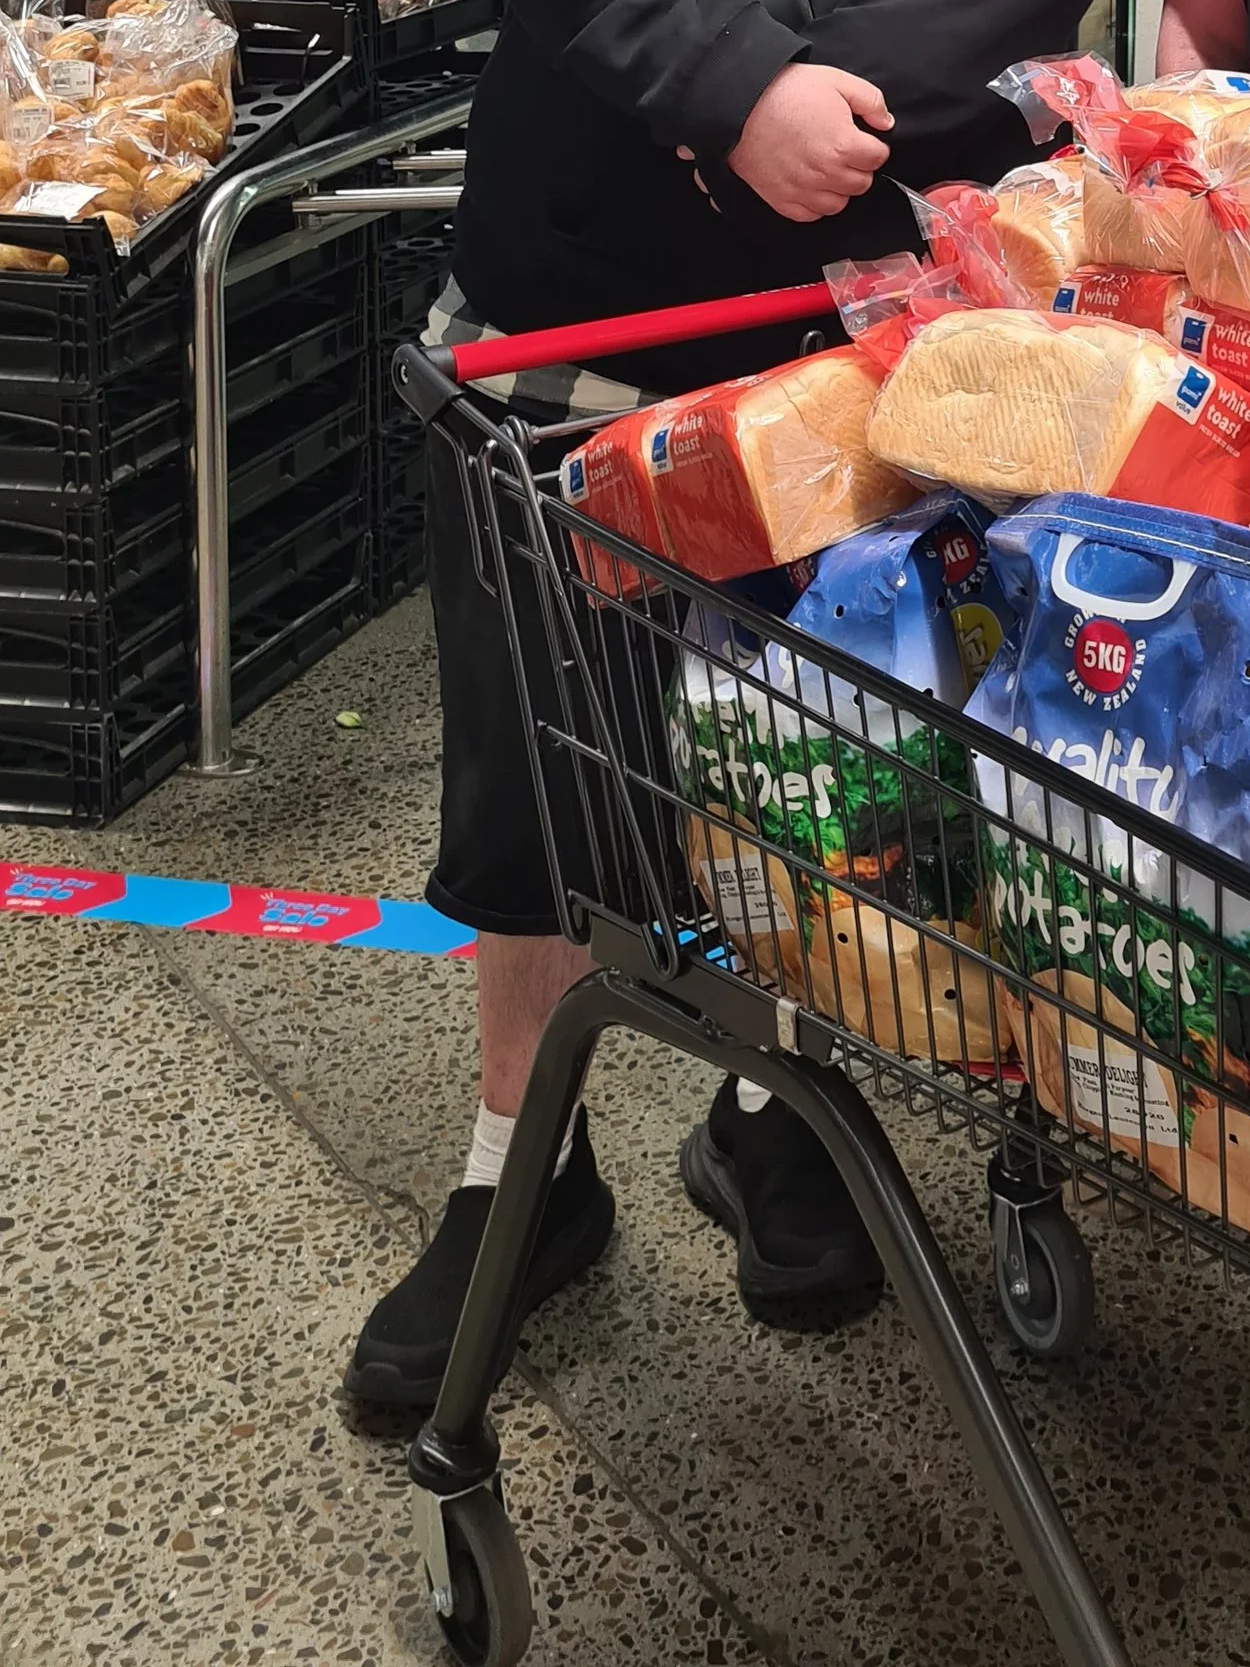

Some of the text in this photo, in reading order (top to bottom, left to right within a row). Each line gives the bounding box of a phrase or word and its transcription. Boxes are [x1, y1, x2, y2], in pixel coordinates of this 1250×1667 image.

[1084, 288, 1120, 306] white
[1212, 343, 1249, 368] toast
[674, 414, 703, 436] white
[1206, 404, 1241, 439] toast
[588, 440, 613, 463] white
[673, 435, 700, 456] toast
[589, 462, 613, 483] toast
[1083, 640, 1126, 674] 5KG
[1065, 639, 1147, 711] NEW ZEALAND
